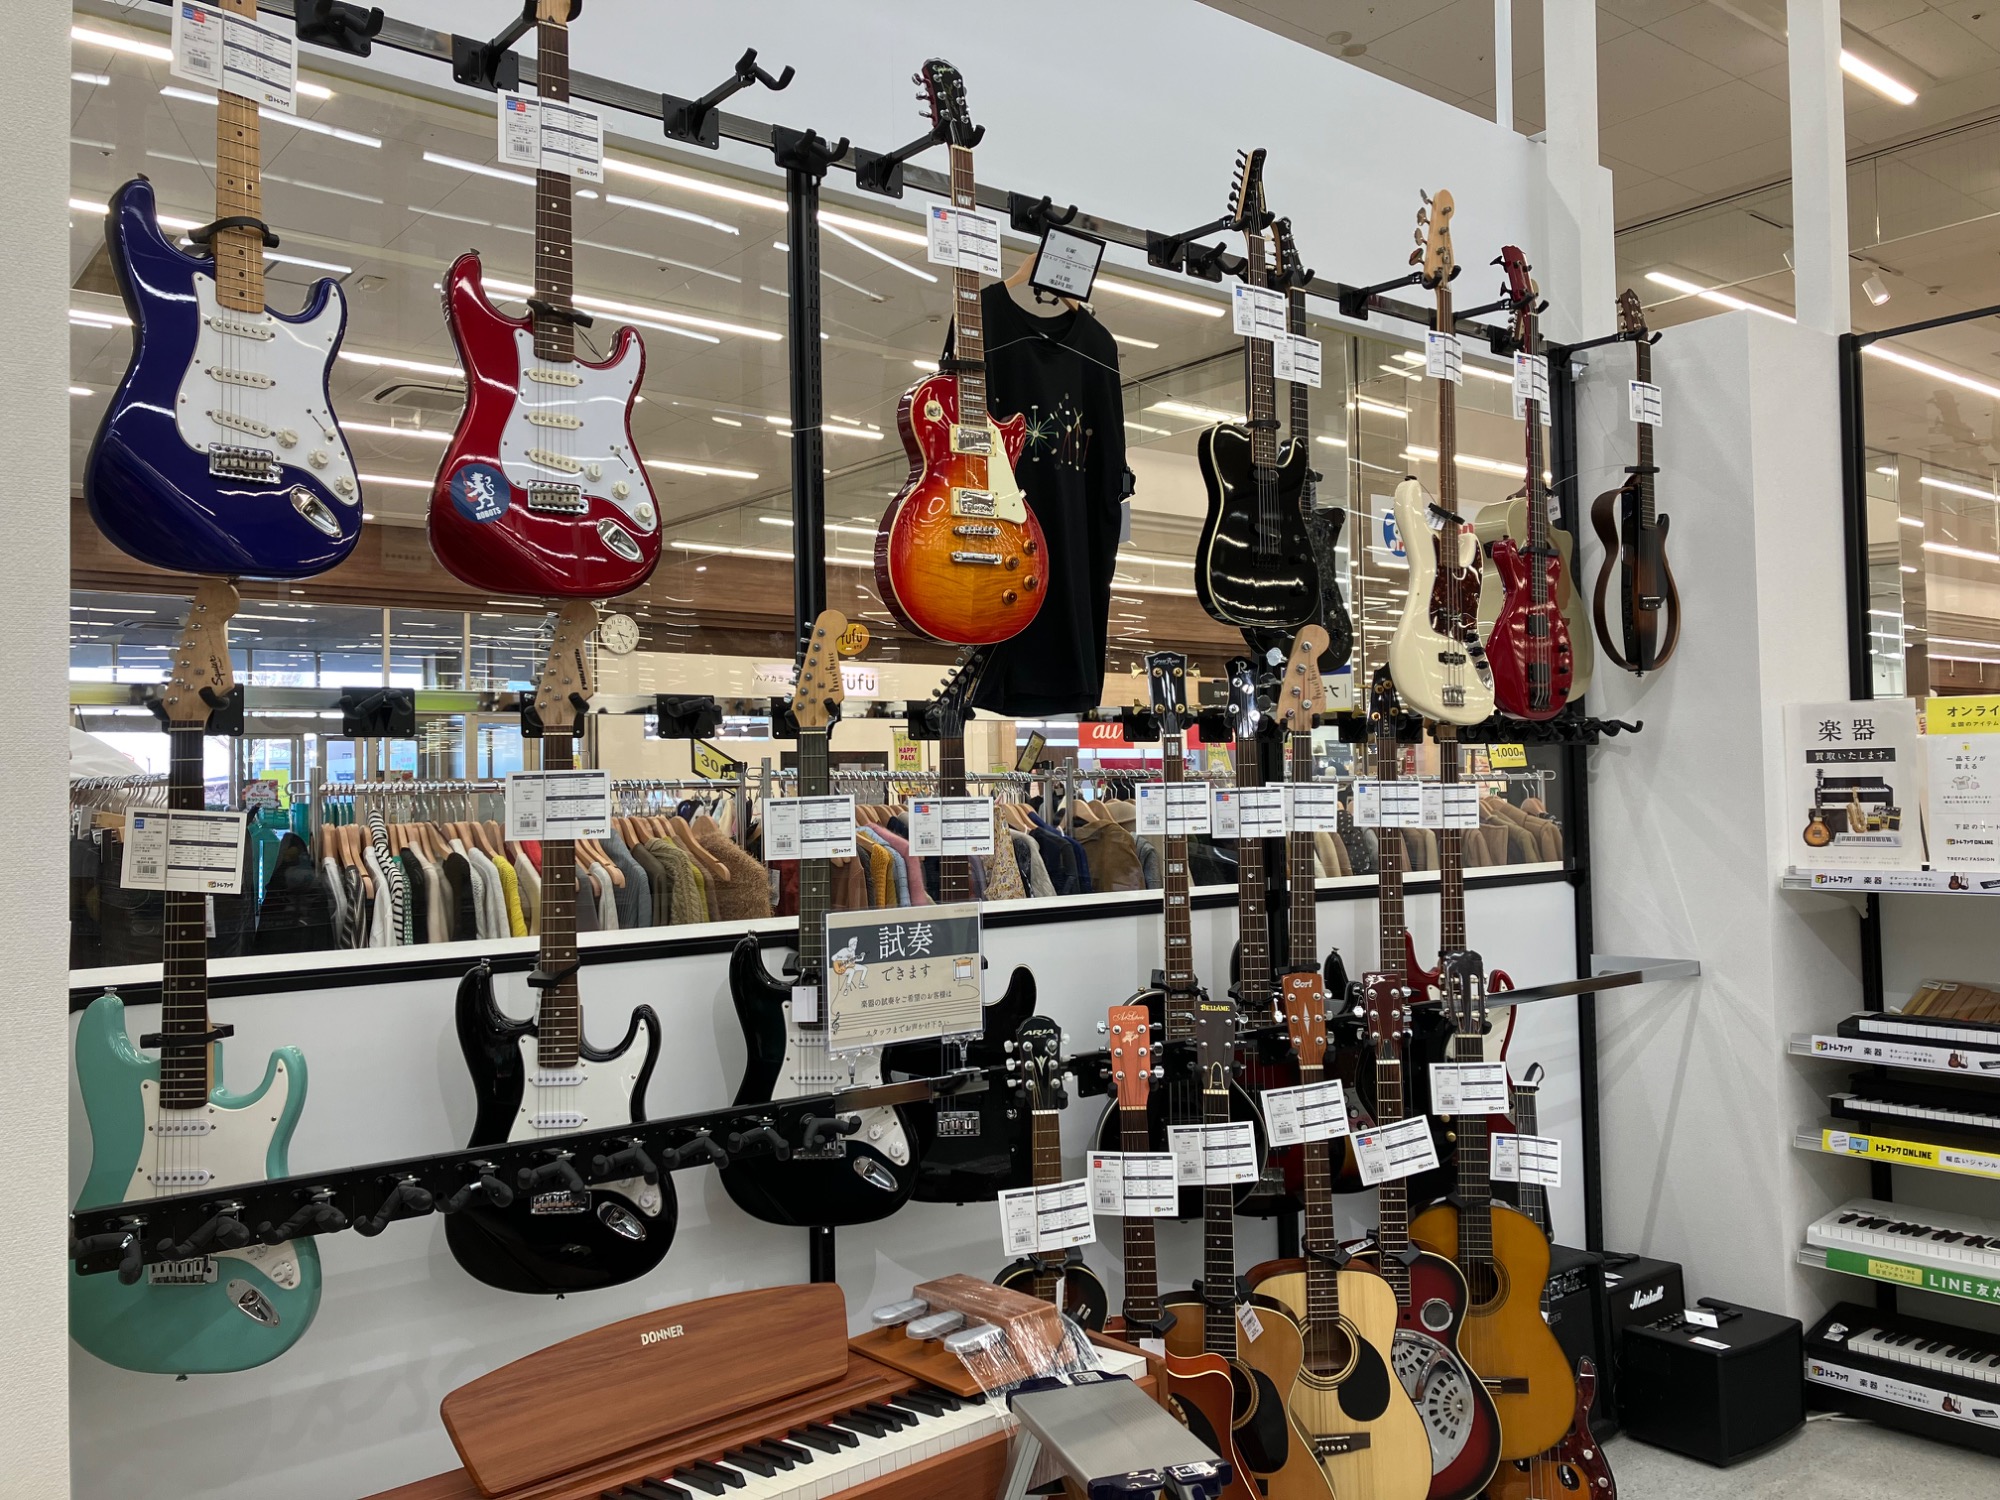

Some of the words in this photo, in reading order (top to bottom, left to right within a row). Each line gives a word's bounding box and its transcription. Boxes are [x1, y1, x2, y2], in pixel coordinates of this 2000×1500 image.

[476, 507, 502, 520] ROBOTS
[1092, 724, 1123, 740] au
[1818, 719, 1876, 742] 楽器
[1815, 751, 1890, 761] 買取いたします。
[1828, 876, 1852, 884] トレファク
[1863, 877, 1882, 885] 楽器
[878, 922, 933, 959] 試奏
[881, 963, 931, 981] できます
[1293, 978, 1313, 989] Cort
[860, 990, 952, 1008] 楽器の試奏をご希望のお客様は
[1022, 1028, 1055, 1037] ARIA
[1828, 1043, 1853, 1053] トレファク
[1863, 1047, 1882, 1057] 楽器
[1875, 1144, 1902, 1156] トレファク
[1902, 1150, 1932, 1160] ONLINE
[1630, 1285, 1664, 1310] Marshall
[641, 1324, 684, 1346] DONNER
[1825, 1369, 1848, 1382] トレファク
[1860, 1379, 1878, 1390] 楽器
